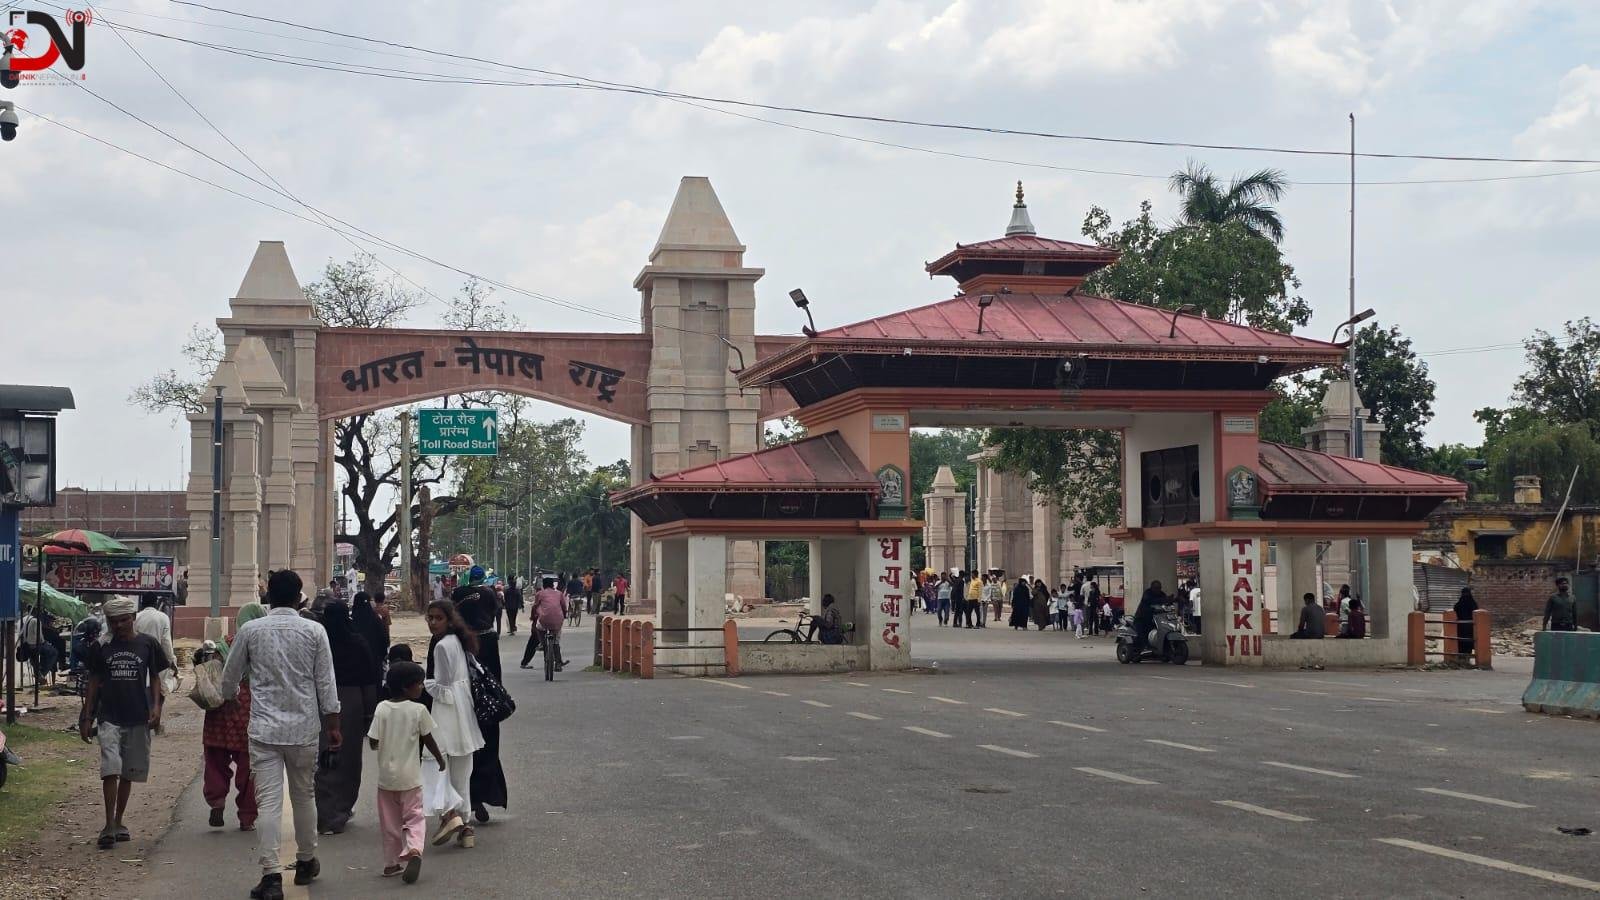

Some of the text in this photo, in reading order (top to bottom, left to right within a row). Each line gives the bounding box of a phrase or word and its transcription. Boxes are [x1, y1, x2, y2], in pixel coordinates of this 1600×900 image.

[341, 351, 424, 391] भारत
[455, 337, 544, 381] नेपाल
[432, 412, 476, 425] टोल रोड
[422, 440, 496, 449] Toll Road Start
[1231, 539, 1253, 629] THANK
[1227, 635, 1262, 656] YOU
